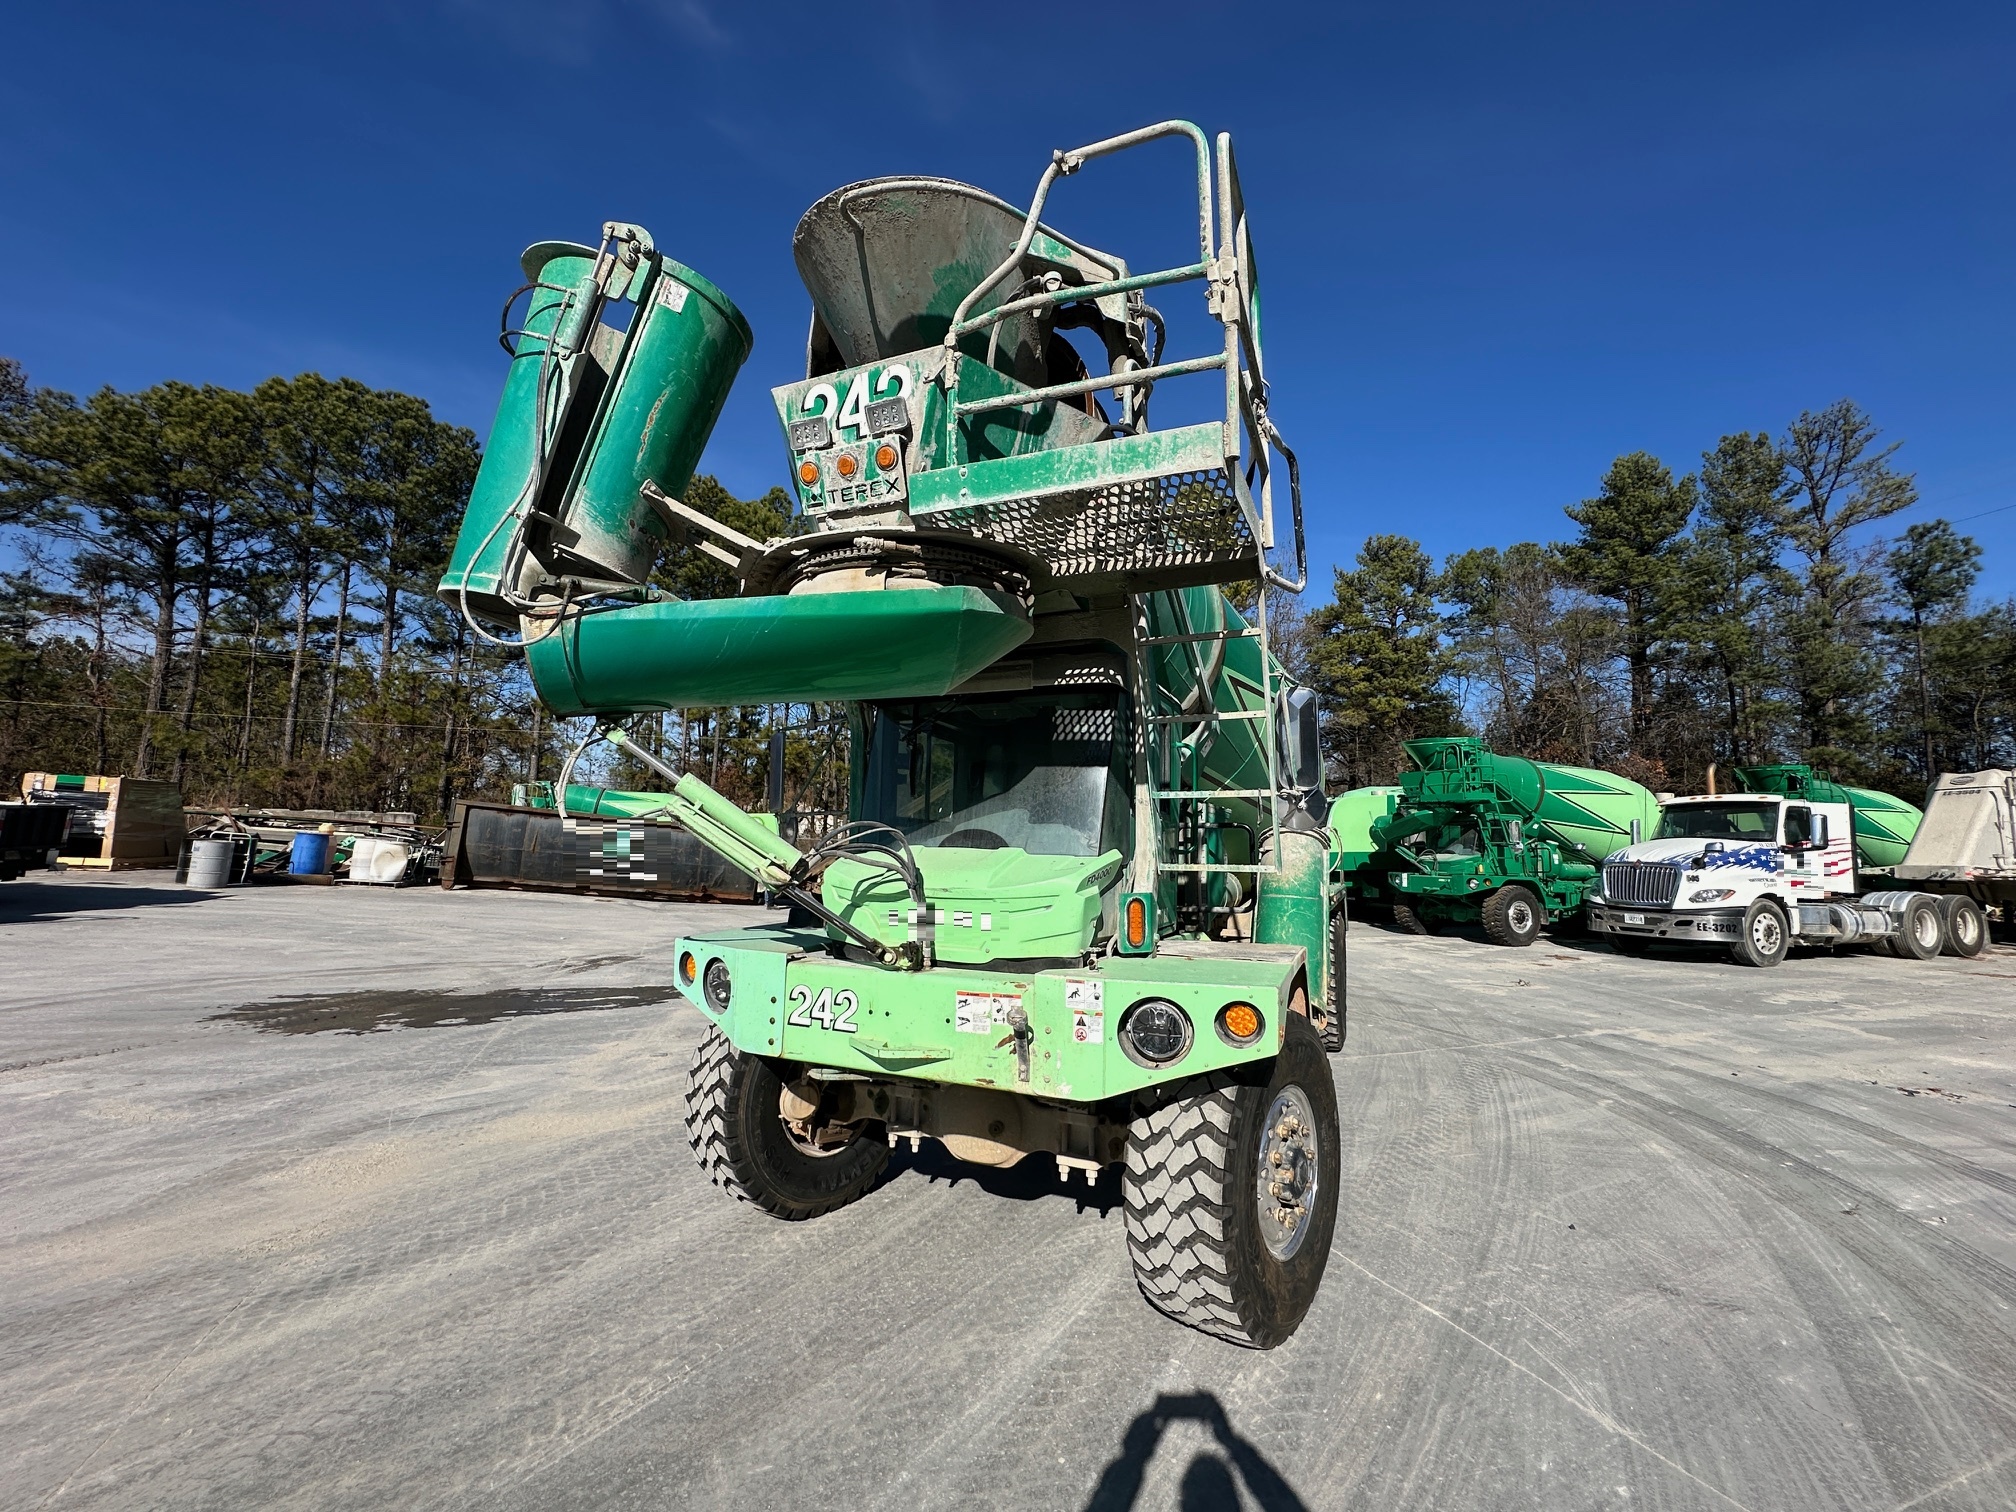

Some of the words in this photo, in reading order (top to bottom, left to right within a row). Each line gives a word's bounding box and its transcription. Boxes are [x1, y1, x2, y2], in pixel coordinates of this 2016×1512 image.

[801, 363, 912, 439] 242
[827, 477, 900, 504] TEREX
[1696, 922, 1738, 933] EE-3202
[787, 984, 859, 1033] 242
